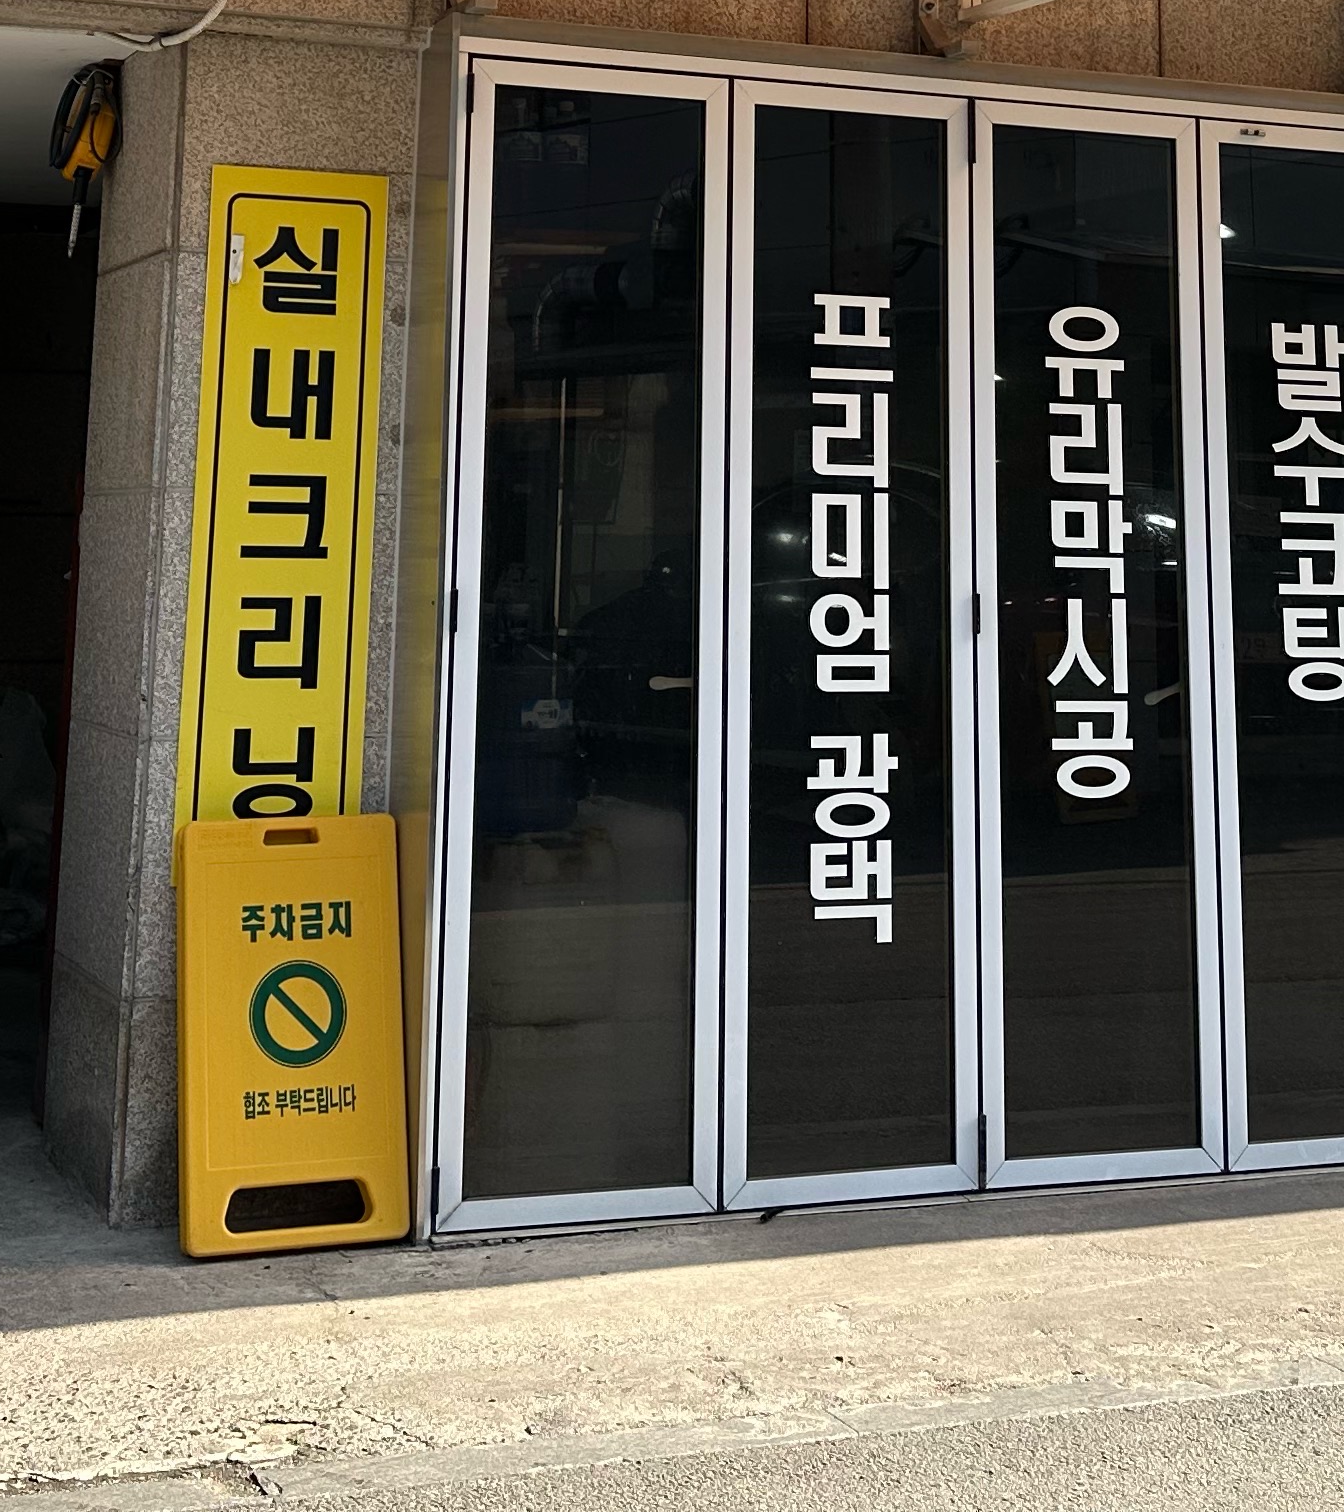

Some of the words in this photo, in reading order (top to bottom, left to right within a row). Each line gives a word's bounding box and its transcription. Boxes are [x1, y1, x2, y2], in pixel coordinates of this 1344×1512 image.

[232, 225, 341, 817] 실내크리닝
[810, 293, 894, 693] 프리미엄
[1045, 306, 1134, 799] 유리막시공
[242, 901, 352, 942] 주차금지
[807, 733, 899, 944] 광택
[243, 1090, 271, 1120] 협조
[275, 1084, 357, 1118] 부탁드립니다
